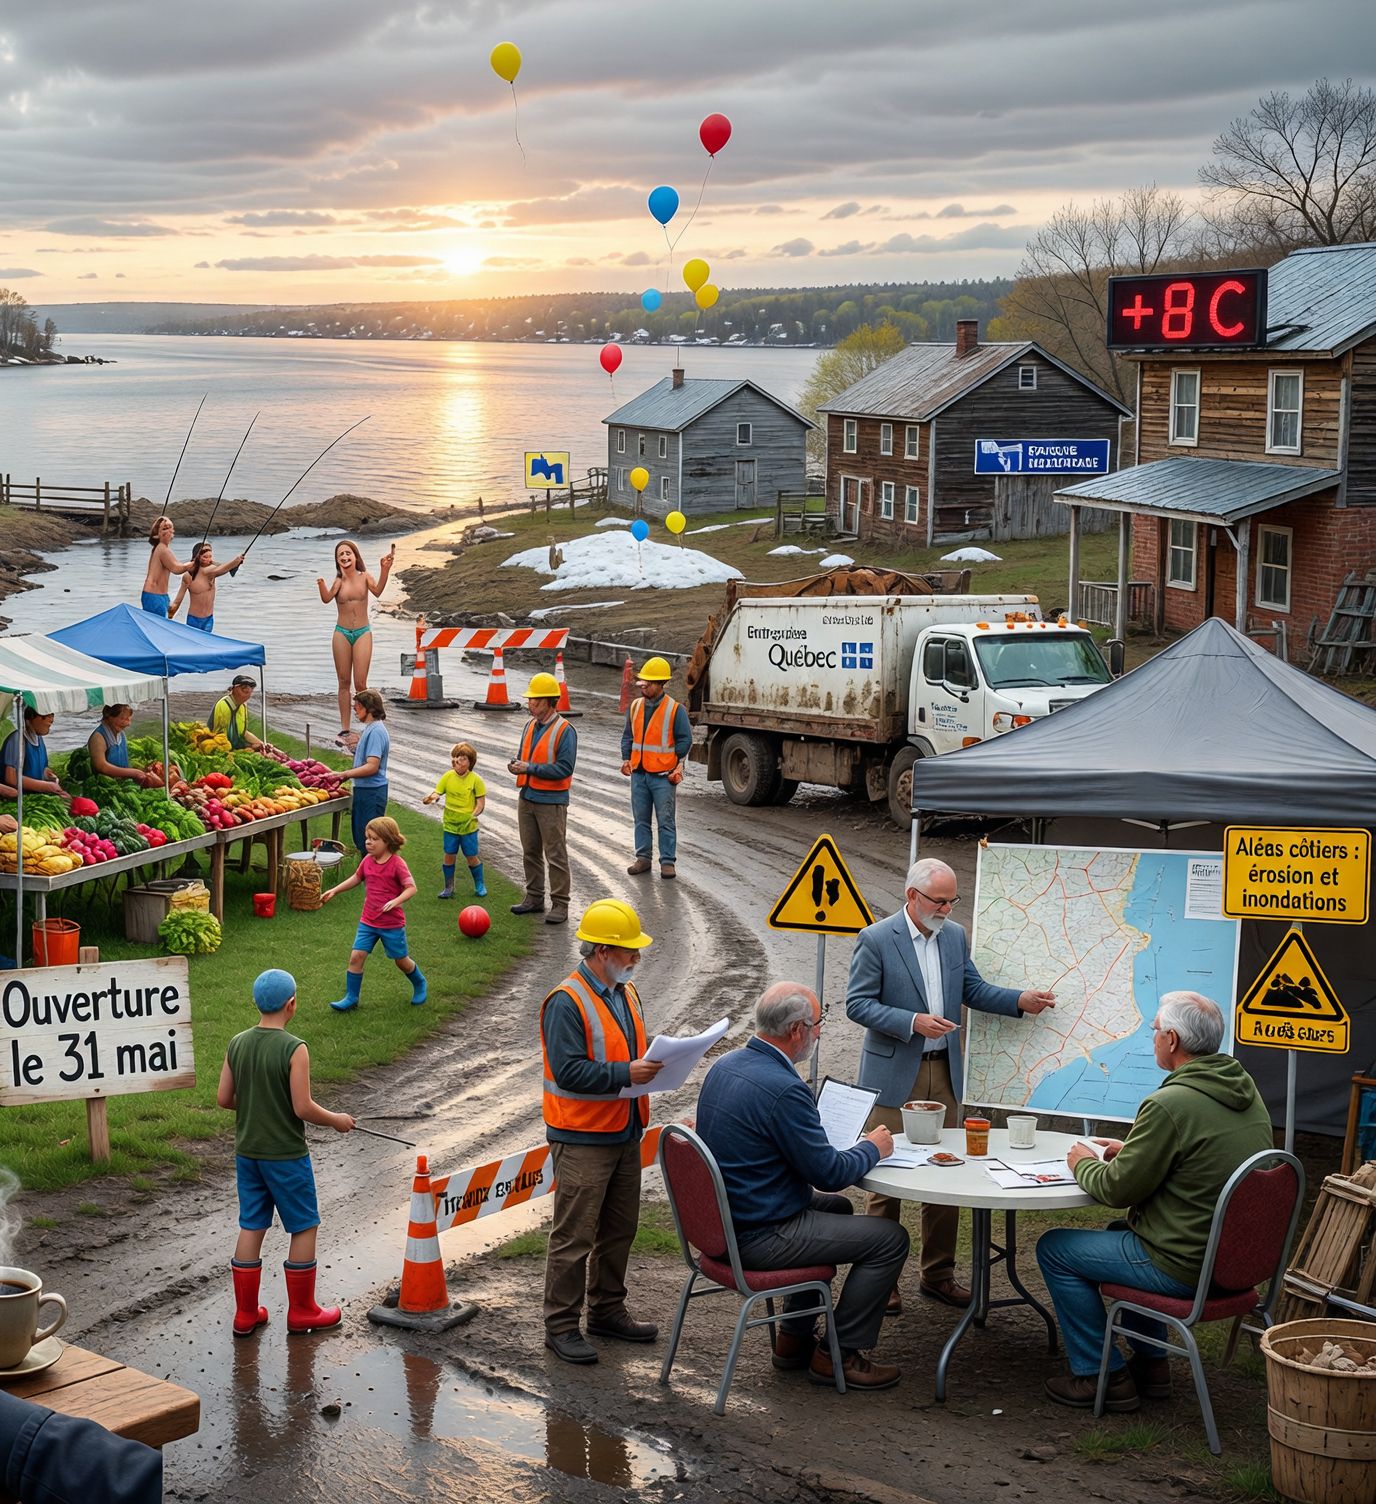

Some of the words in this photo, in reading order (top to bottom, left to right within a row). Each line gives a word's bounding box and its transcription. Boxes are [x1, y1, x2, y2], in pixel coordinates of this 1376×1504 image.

[768, 643, 837, 672] Québec
[1235, 836, 1285, 858] Aléas
[1289, 837, 1349, 860] côtiers
[1248, 863, 1315, 886] érosion
[1320, 867, 1340, 887] et
[1242, 888, 1348, 912] inondations
[2, 977, 181, 1029] Ouverture
[11, 1039, 45, 1088] le
[58, 1030, 105, 1083] 31
[116, 1028, 178, 1076] mai
